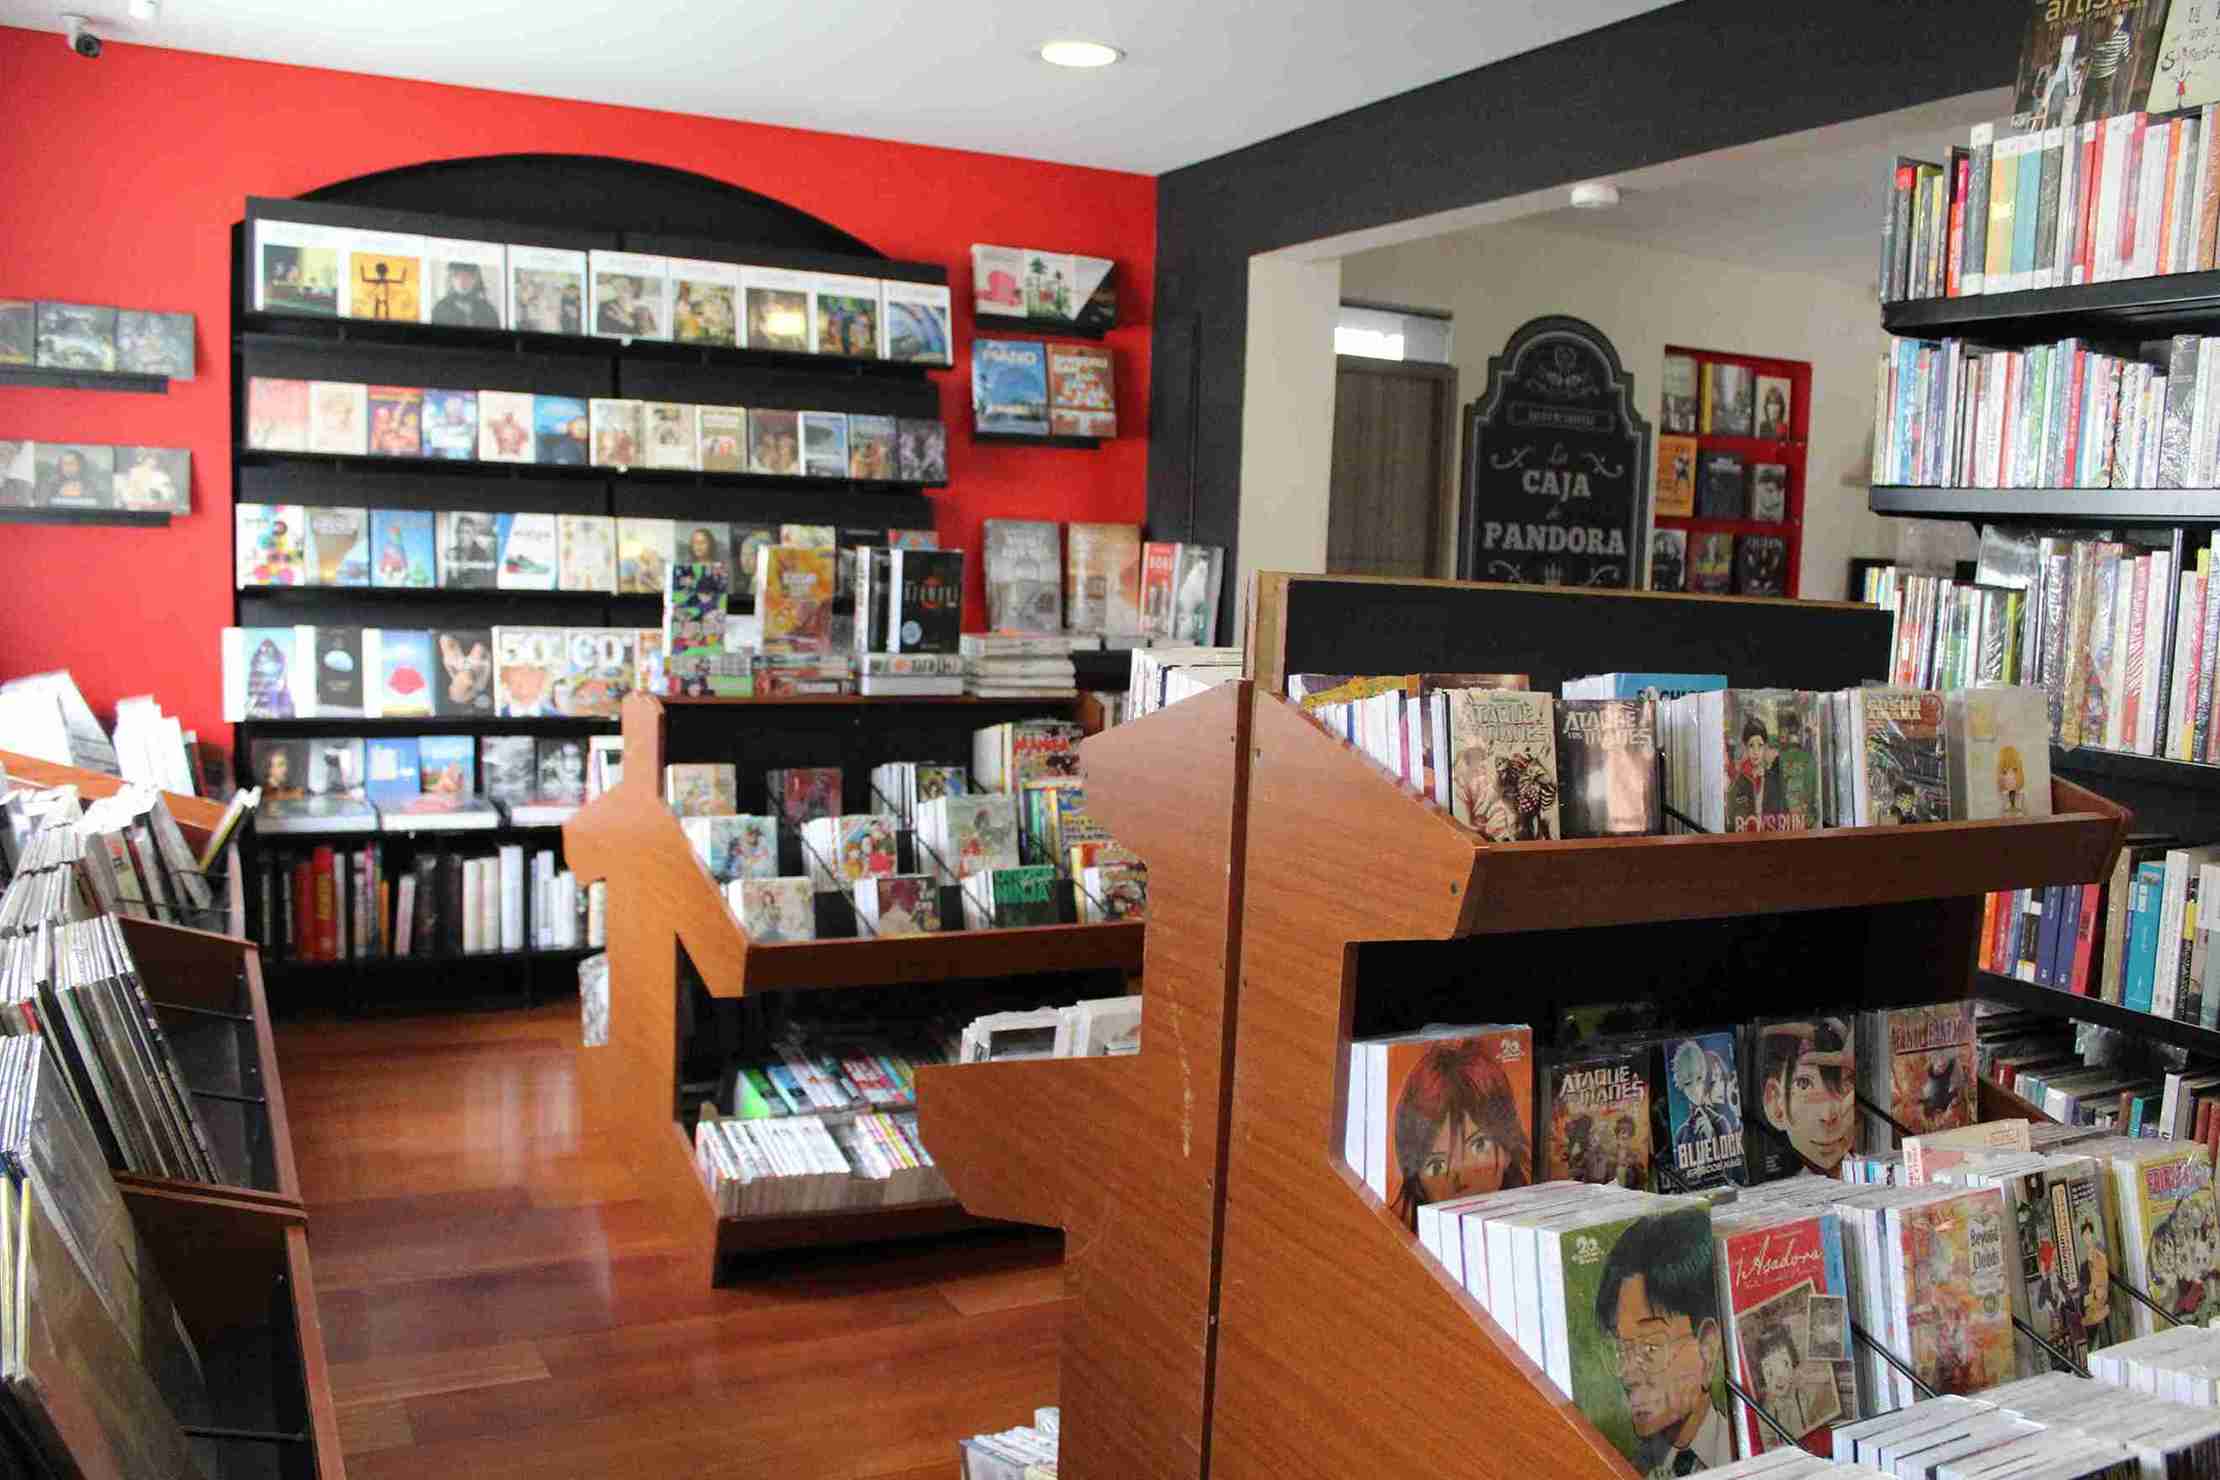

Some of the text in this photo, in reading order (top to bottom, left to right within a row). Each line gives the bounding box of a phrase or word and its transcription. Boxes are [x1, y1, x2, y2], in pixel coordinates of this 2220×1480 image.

[1522, 469, 1591, 502] CAJA
[1483, 521, 1625, 556] PANDORA
[1560, 1065, 1630, 1098] ATAQUE
